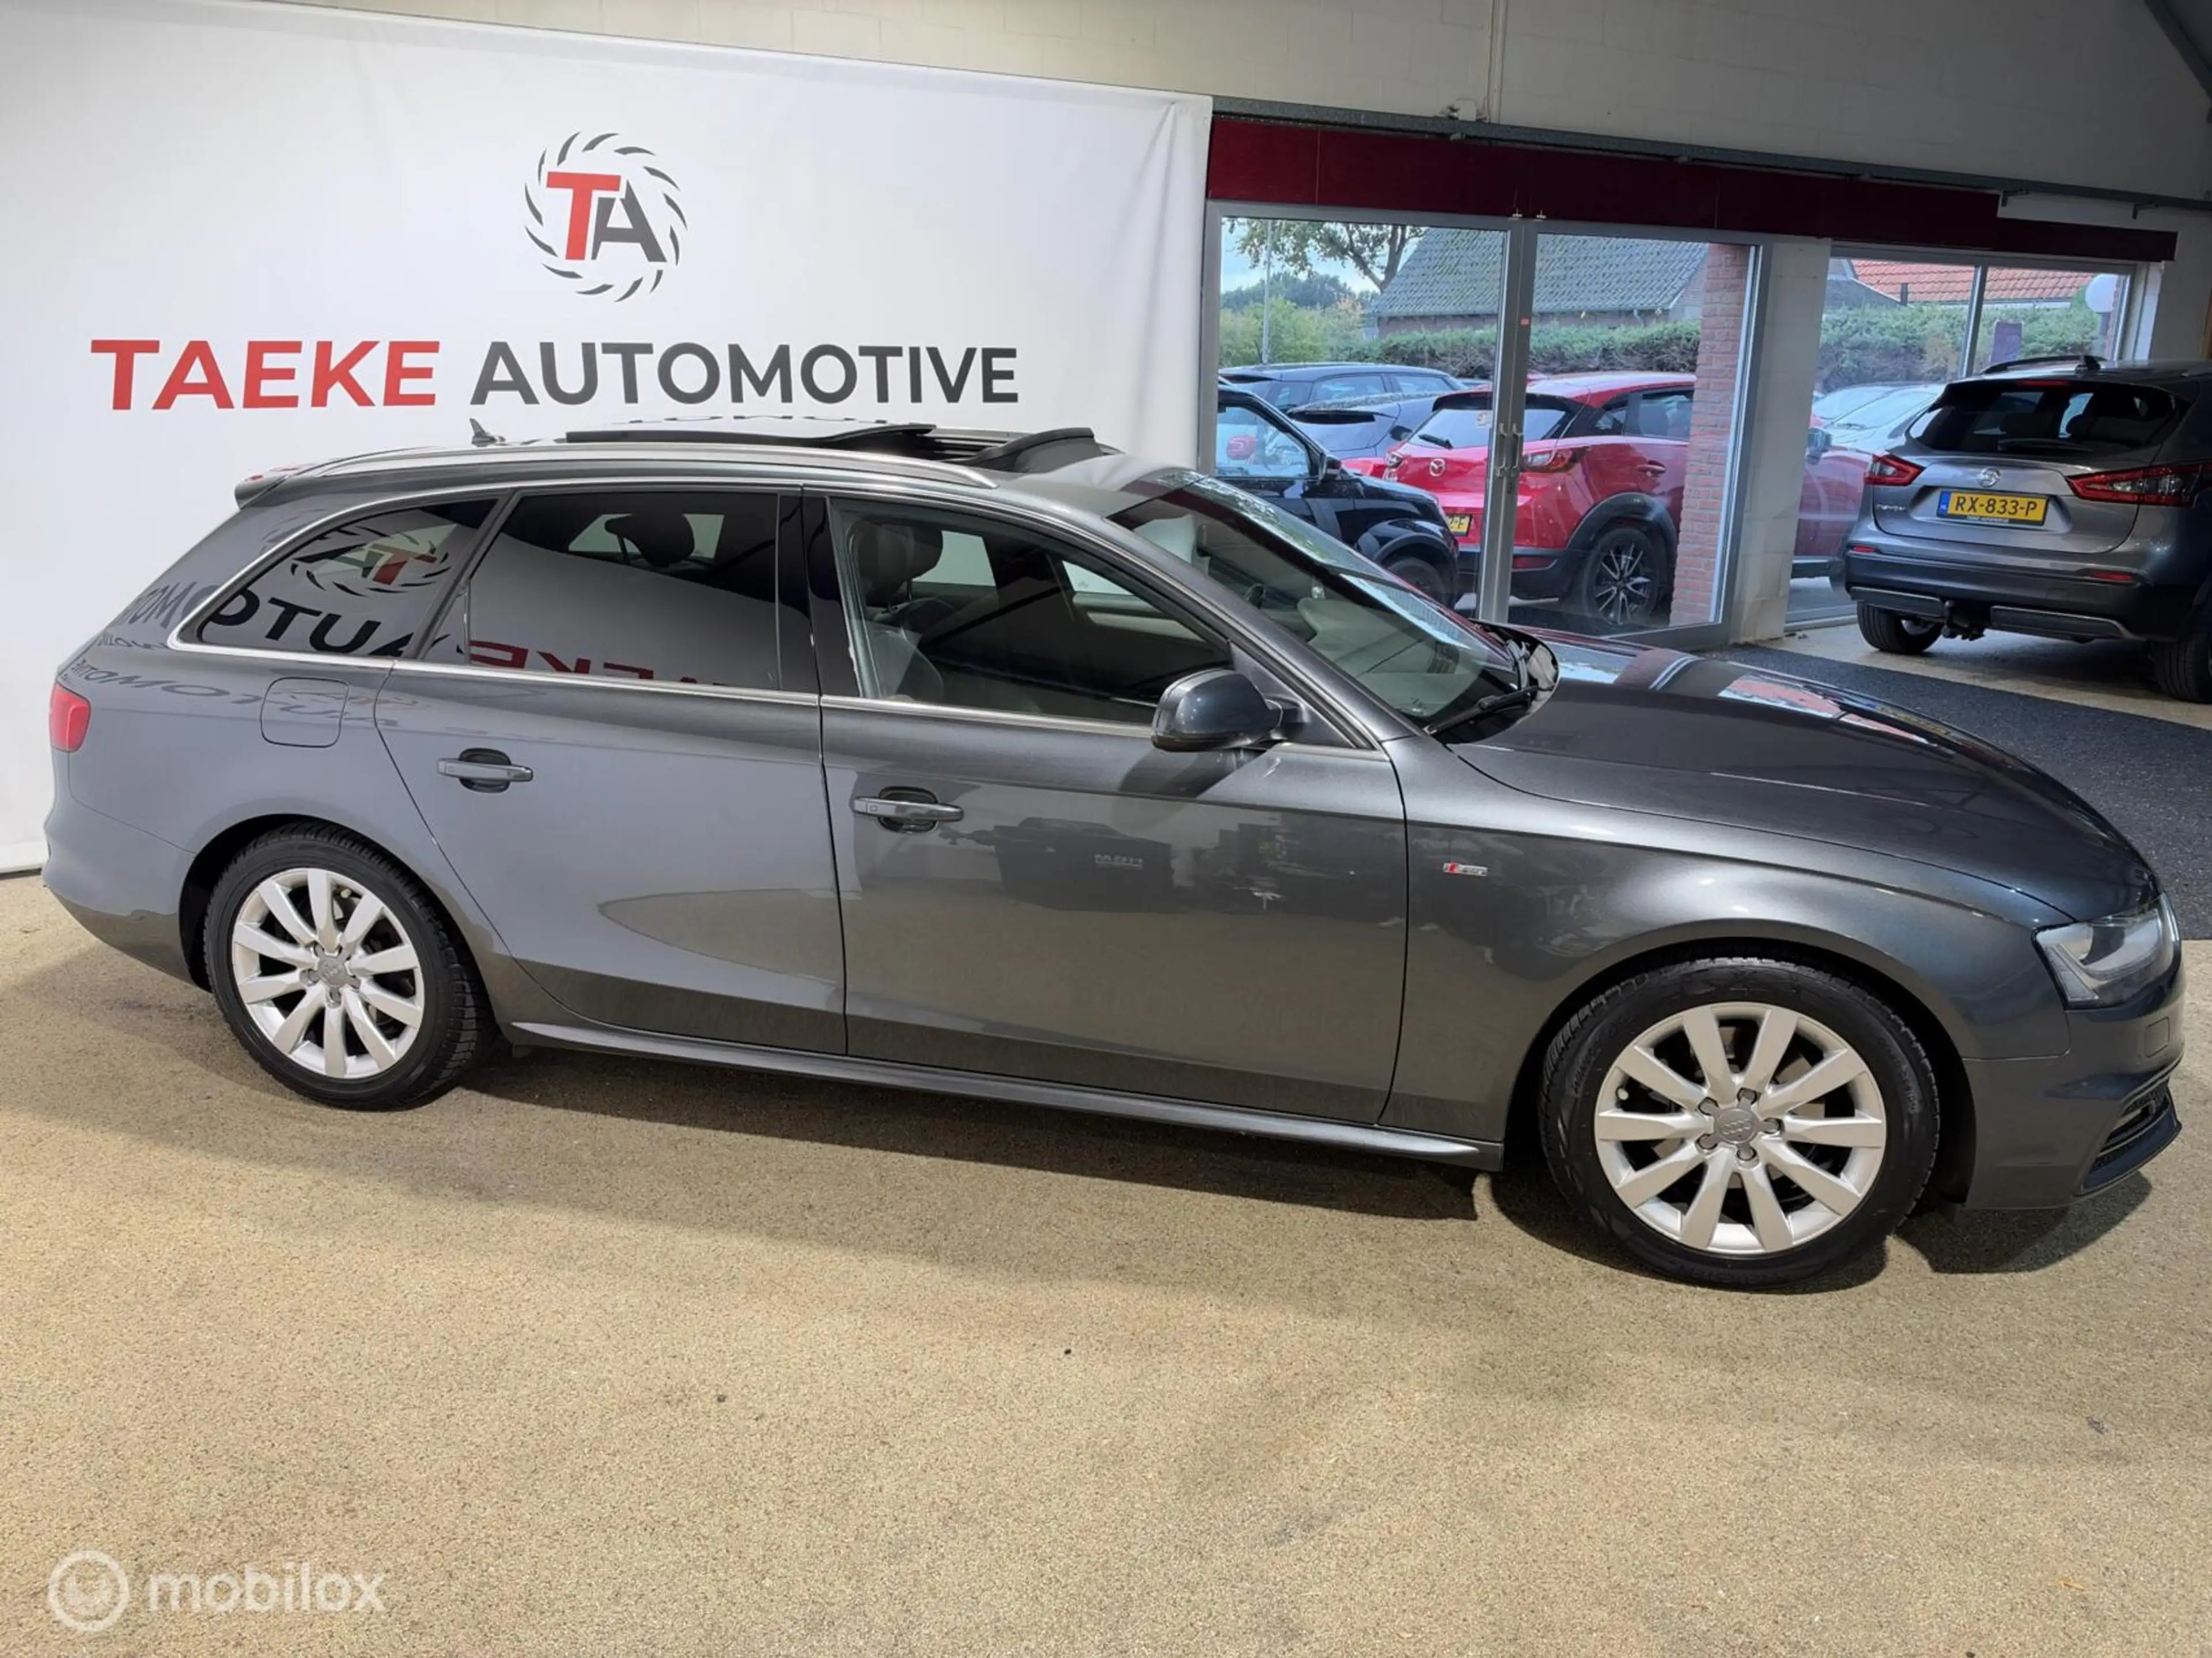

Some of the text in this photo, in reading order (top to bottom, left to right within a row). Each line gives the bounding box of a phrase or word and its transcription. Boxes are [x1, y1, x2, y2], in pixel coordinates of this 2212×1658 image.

[547, 172, 667, 263] TA
[91, 339, 1018, 410] TAEKE AUTOMOTIVE
[1955, 496, 2037, 517] RX-833-P
